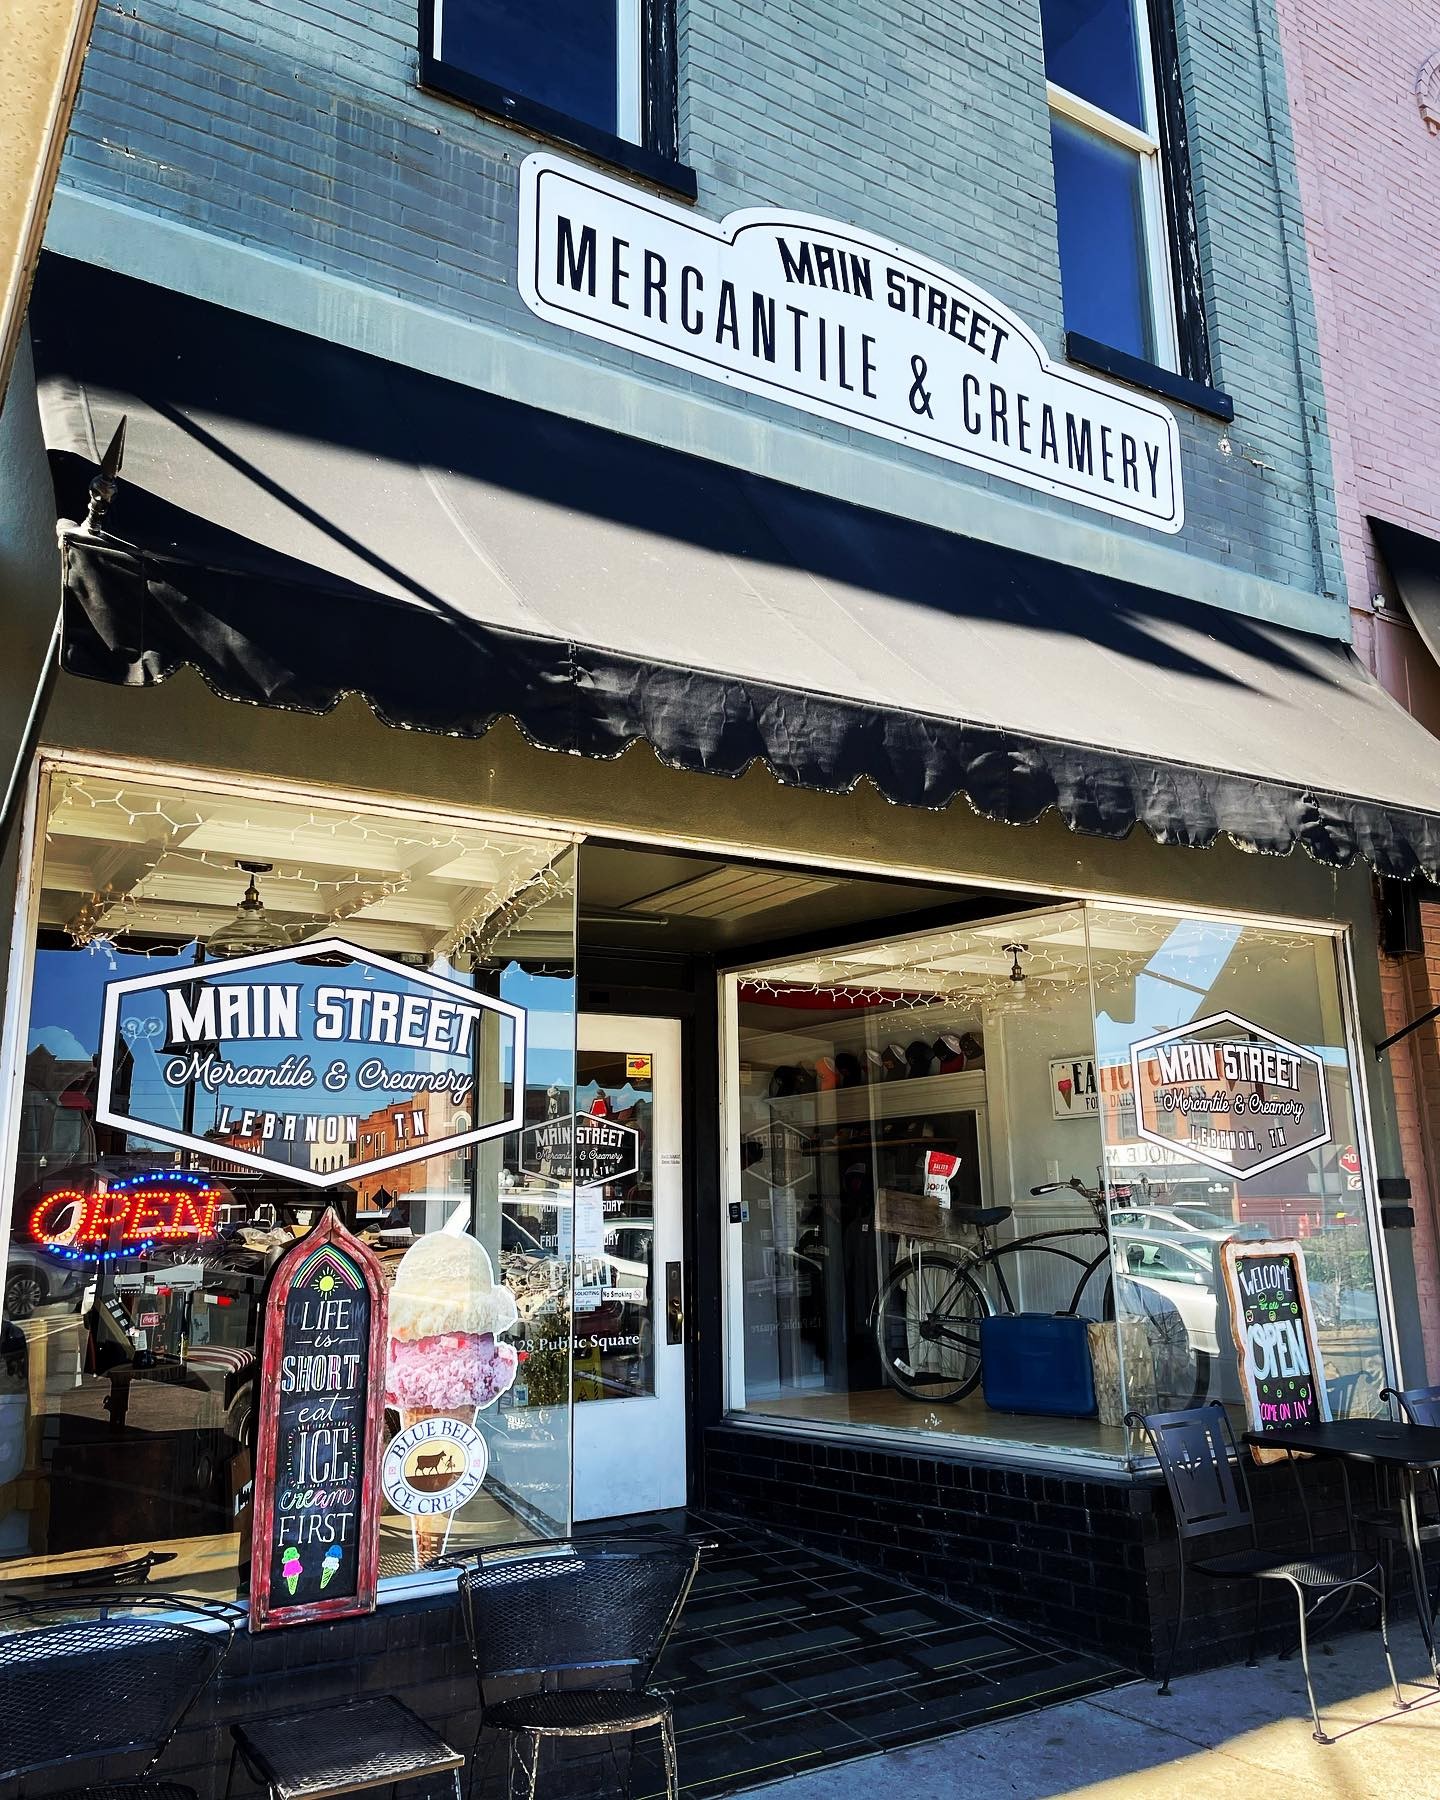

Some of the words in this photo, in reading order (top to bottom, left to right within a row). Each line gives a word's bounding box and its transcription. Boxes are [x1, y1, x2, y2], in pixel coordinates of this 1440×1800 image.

[775, 236, 874, 301] MAIN
[886, 267, 1009, 364] STREET
[556, 214, 877, 400] MERCANTILE
[908, 354, 935, 420] &
[962, 373, 1160, 499] CREAMERY
[165, 985, 300, 1044] MAIN
[314, 986, 482, 1057] STREET
[165, 1052, 315, 1090] Mercantile
[324, 1061, 349, 1090] &
[357, 1060, 475, 1104] Creamery
[1156, 1044, 1220, 1085] MAIN
[1222, 1043, 1301, 1091] STREET
[395, 1110, 427, 1138] TN
[1163, 1090, 1230, 1116] Mercantile
[1234, 1094, 1246, 1114] &
[1249, 1093, 1304, 1124] Creamery
[535, 1127, 572, 1147] MAIN
[576, 1127, 625, 1148] STREET
[1269, 1128, 1287, 1147] TN
[32, 1190, 222, 1241] OPEN
[602, 1290, 610, 1298] No
[611, 1289, 632, 1300] Smoking
[1239, 1264, 1292, 1296] WELCOME
[301, 1299, 351, 1331] LIFE
[314, 1332, 340, 1348] is
[590, 1334, 640, 1351] Square
[1247, 1319, 1311, 1380] OPEN
[281, 1354, 361, 1393] SHORT
[297, 1393, 350, 1423] eat
[1280, 1403, 1291, 1421] ON
[1294, 1400, 1307, 1420] IN
[391, 1421, 436, 1459] BLUE
[442, 1420, 477, 1450] BELL
[297, 1429, 349, 1485] ICE
[280, 1489, 355, 1511] cream
[388, 1480, 415, 1510] ICE
[417, 1472, 478, 1513] CREAM
[278, 1513, 353, 1547] FIRST
